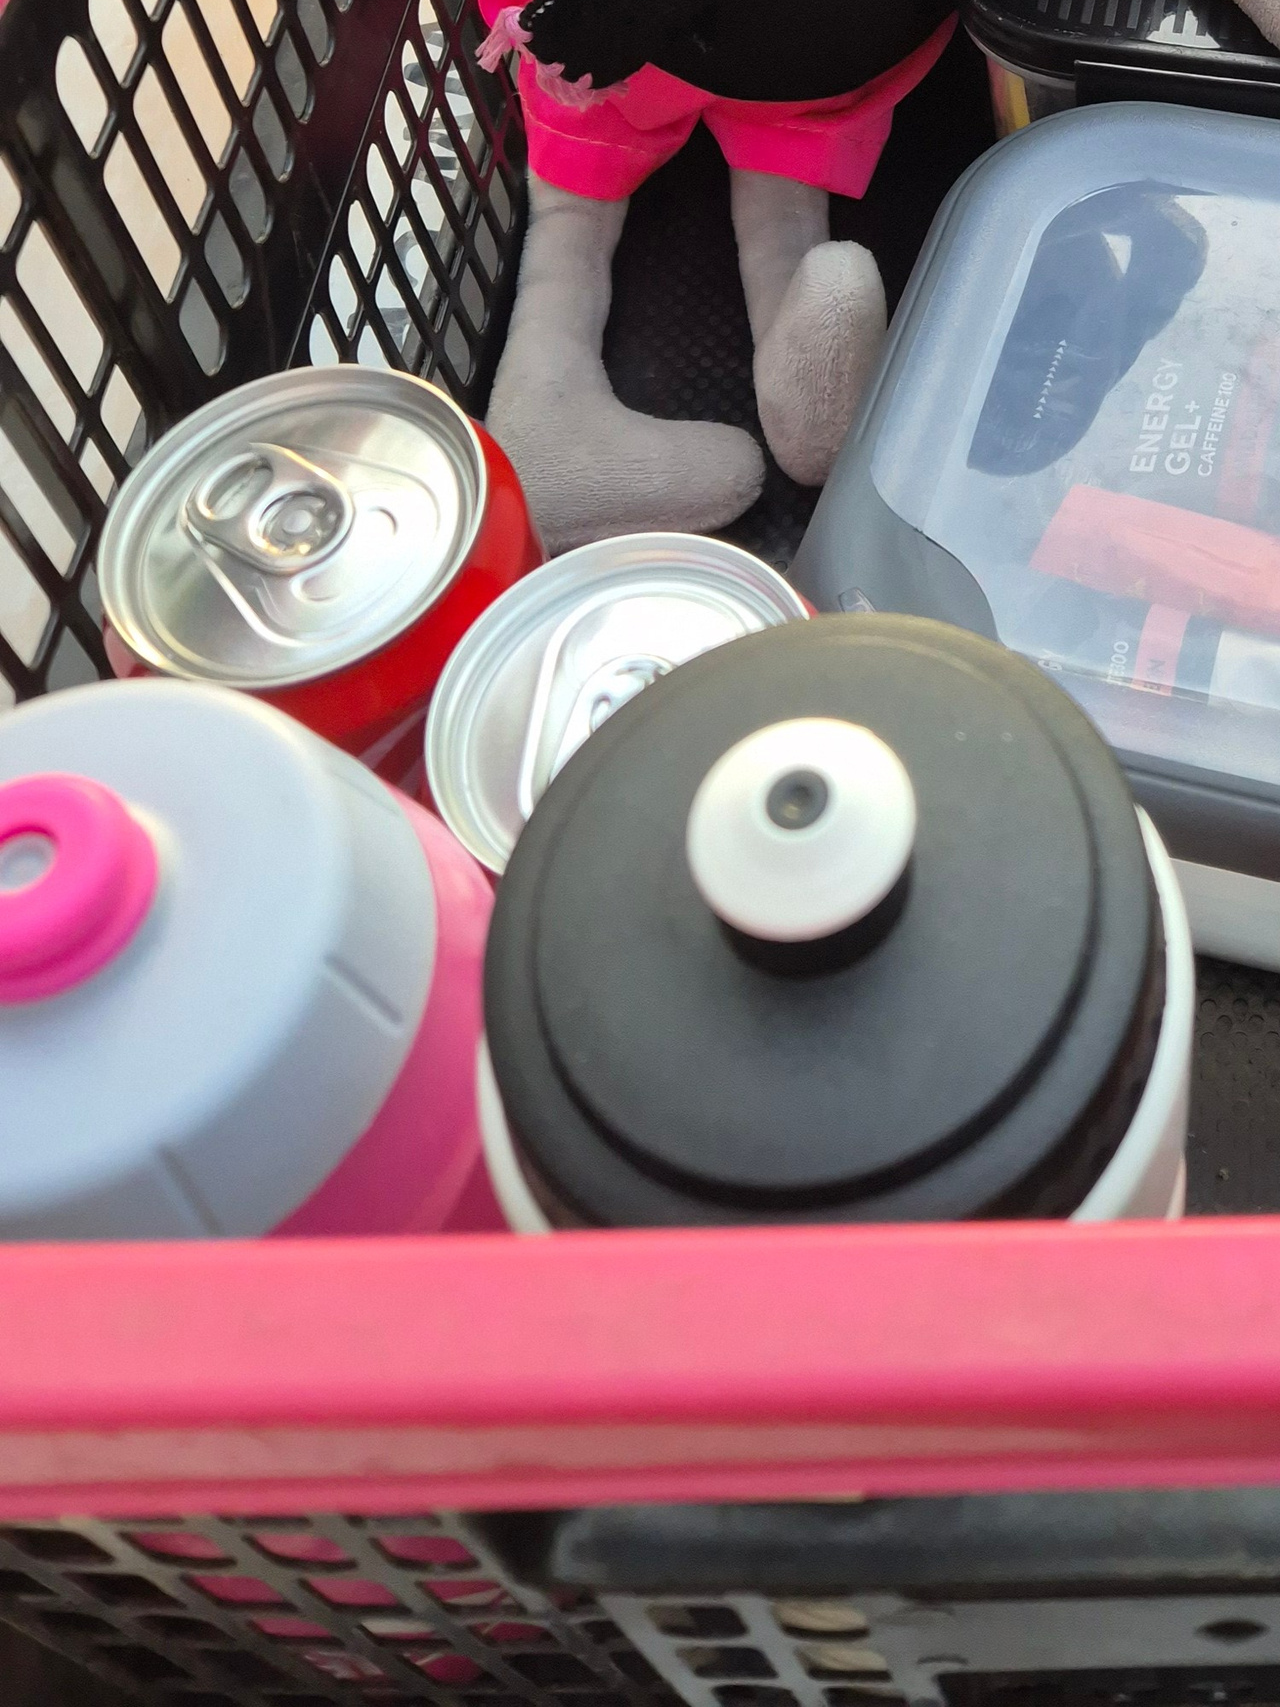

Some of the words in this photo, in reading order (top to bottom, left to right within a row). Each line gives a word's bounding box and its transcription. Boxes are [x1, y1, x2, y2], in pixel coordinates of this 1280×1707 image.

[1129, 357, 1183, 473] ENERGY
[1164, 400, 1201, 476] GEL+
[1197, 397, 1230, 477] CAFFEINE
